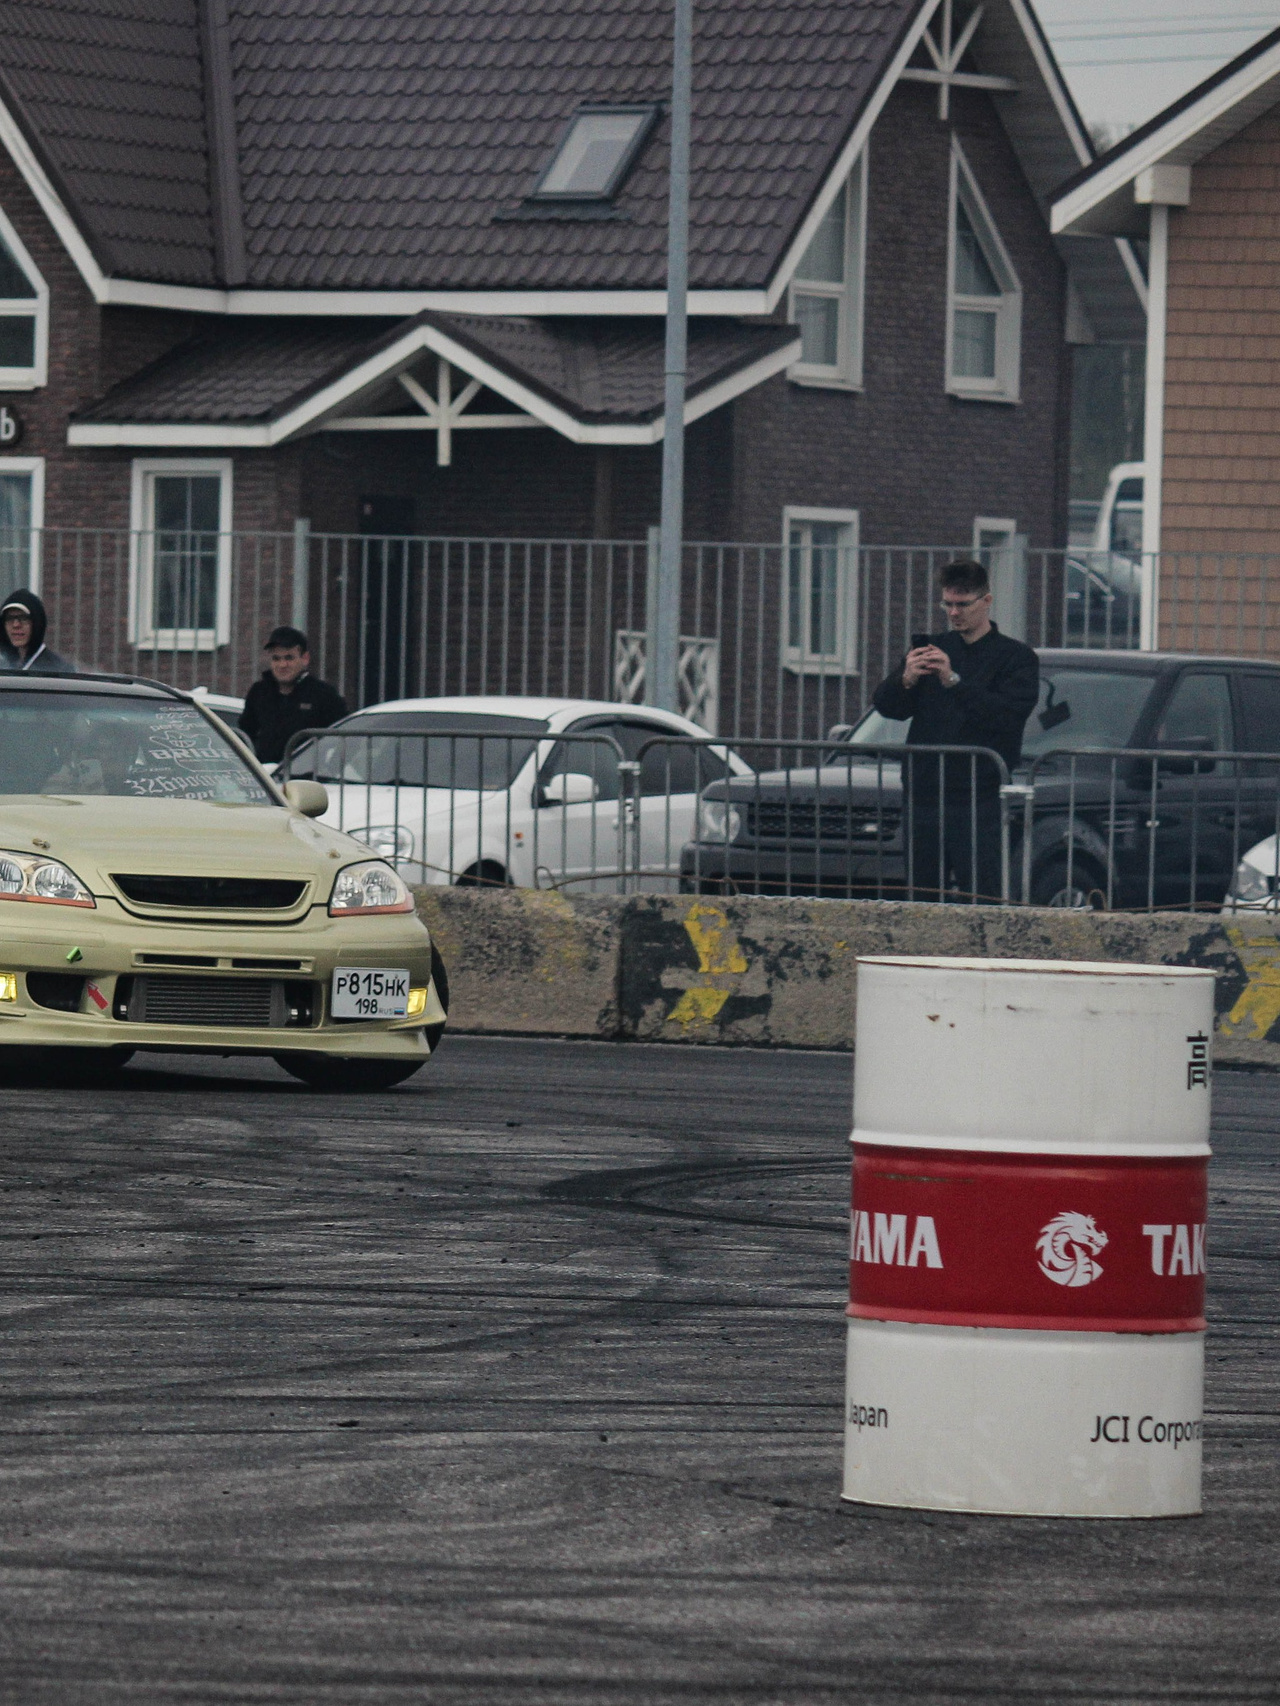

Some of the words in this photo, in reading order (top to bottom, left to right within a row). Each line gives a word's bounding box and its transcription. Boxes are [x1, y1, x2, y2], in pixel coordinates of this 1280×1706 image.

[355, 998, 378, 1014] 198
[1142, 1224, 1206, 1276] TAK
[1090, 1416, 1129, 1442] JCI
